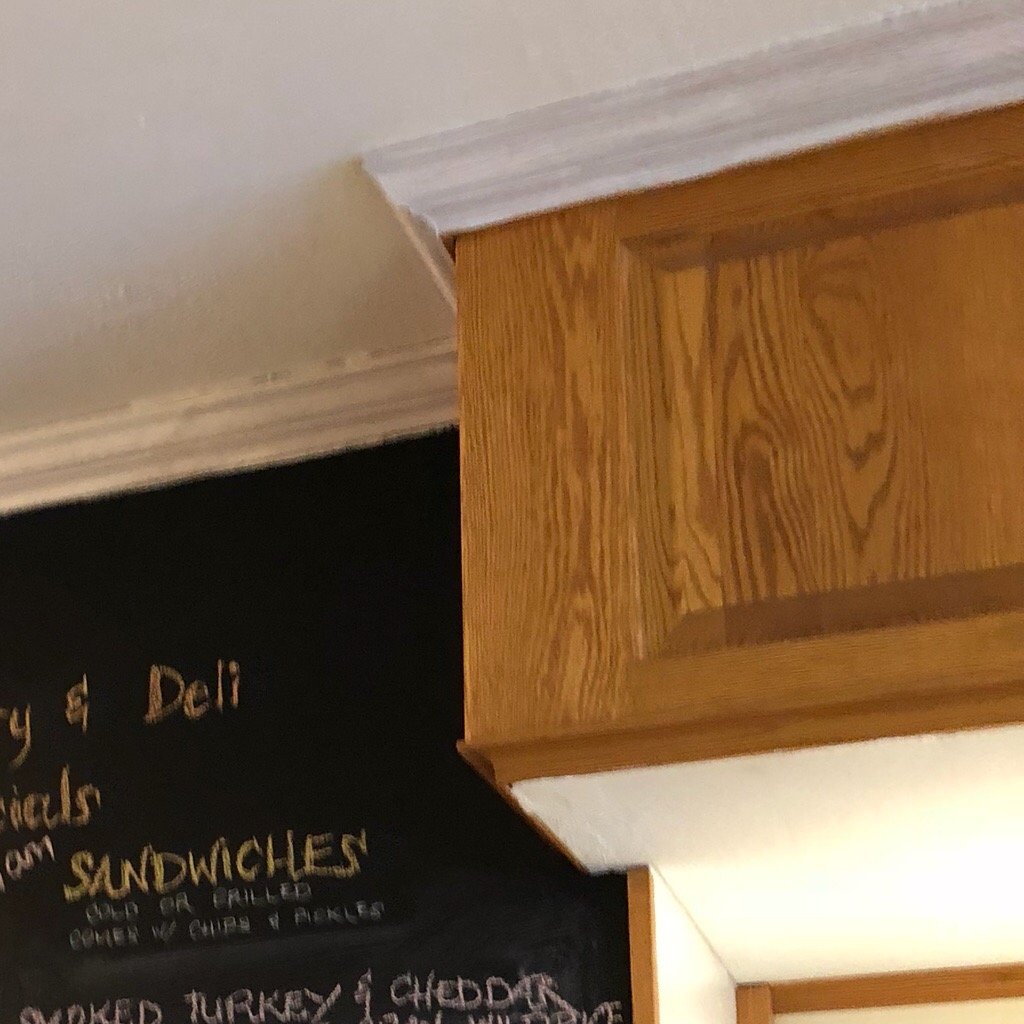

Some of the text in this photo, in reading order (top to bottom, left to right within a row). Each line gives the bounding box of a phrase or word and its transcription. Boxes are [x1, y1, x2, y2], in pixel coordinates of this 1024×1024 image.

[144, 659, 240, 726] Deli
[63, 829, 368, 902] SANDWICHES
[389, 970, 576, 1012] CHEDDAR
